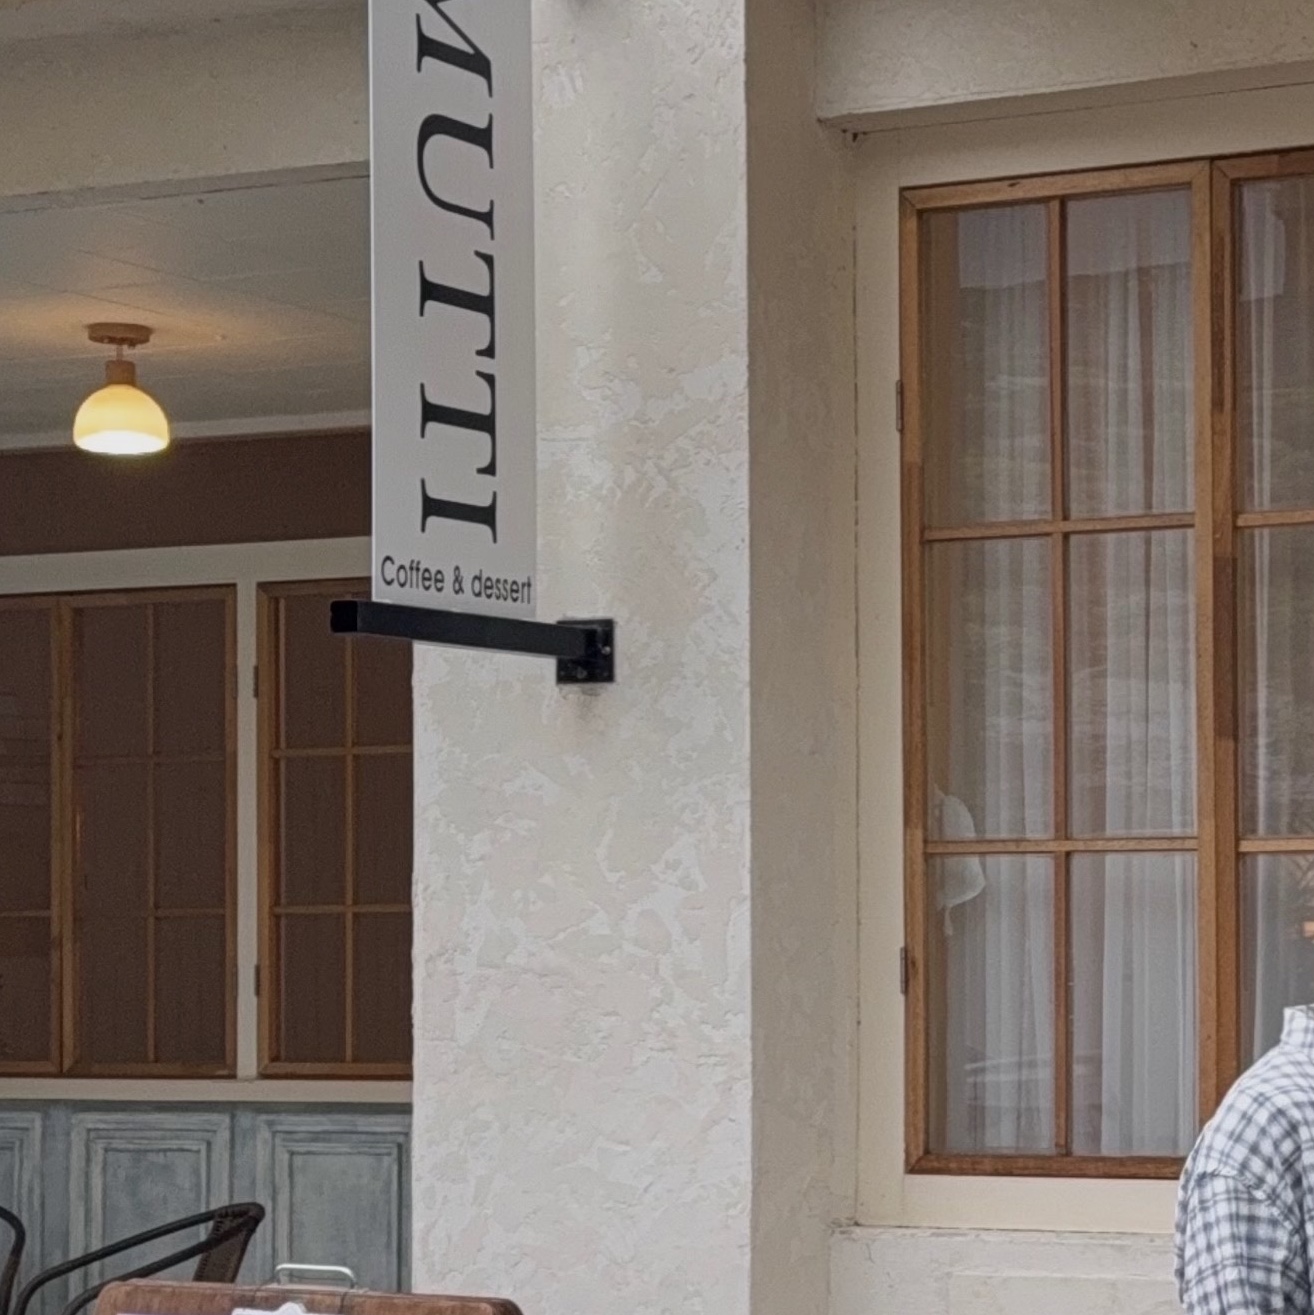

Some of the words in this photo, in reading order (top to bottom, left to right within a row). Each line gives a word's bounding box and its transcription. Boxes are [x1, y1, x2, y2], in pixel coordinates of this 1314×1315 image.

[381, 555, 445, 592] Coffee
[452, 565, 465, 595] &
[471, 569, 532, 604] dessert
